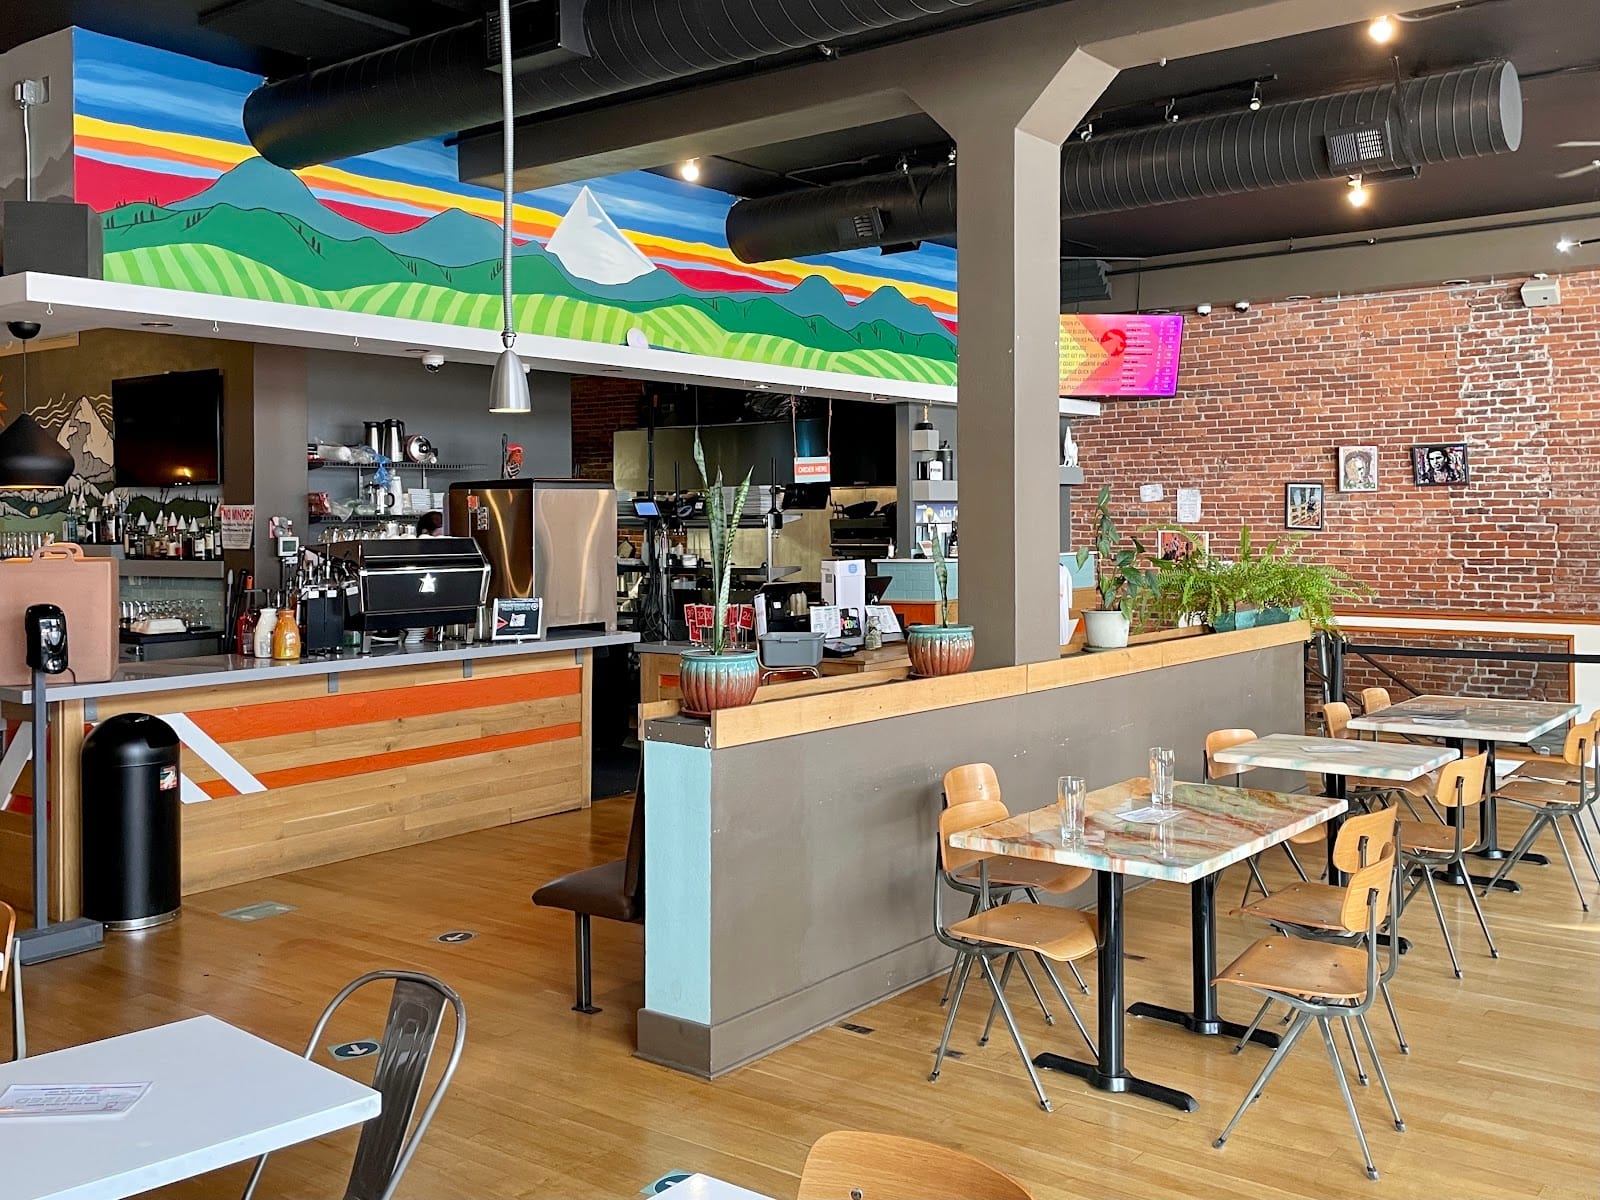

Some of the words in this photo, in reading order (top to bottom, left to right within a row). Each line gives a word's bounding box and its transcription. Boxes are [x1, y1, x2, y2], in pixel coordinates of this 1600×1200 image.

[223, 509, 231, 520] NO
[232, 509, 253, 520] MINORS
[742, 611, 751, 621] 26
